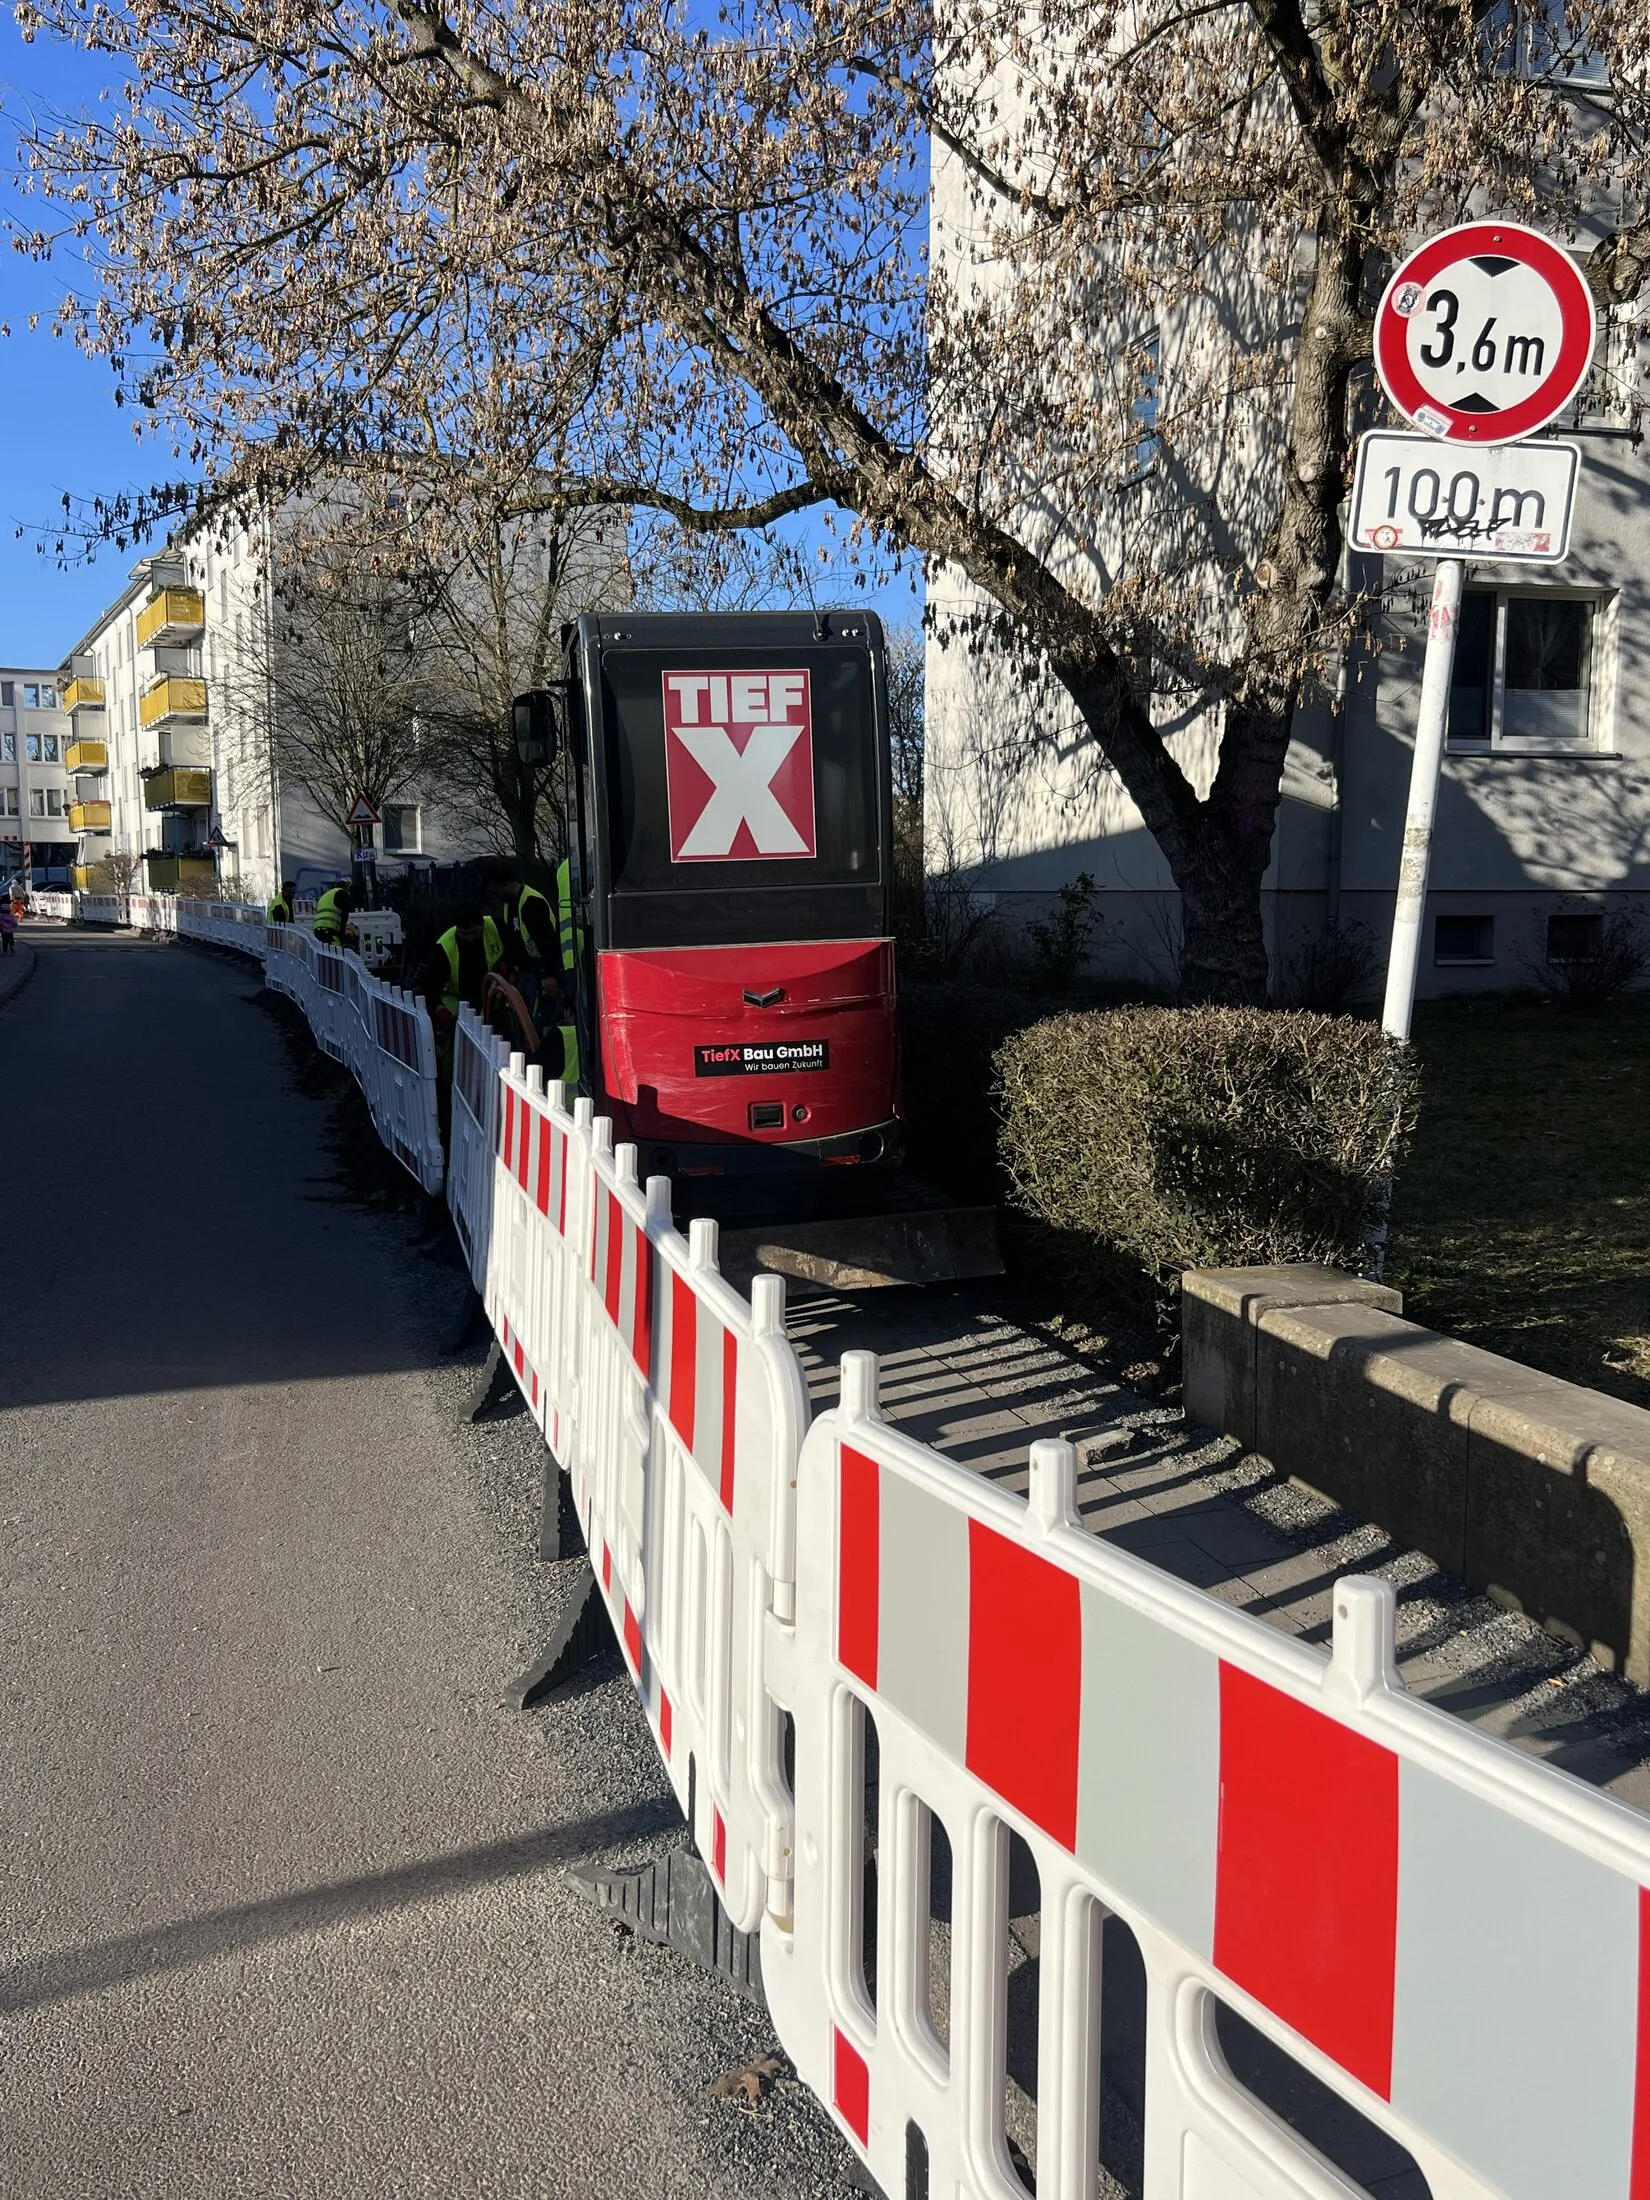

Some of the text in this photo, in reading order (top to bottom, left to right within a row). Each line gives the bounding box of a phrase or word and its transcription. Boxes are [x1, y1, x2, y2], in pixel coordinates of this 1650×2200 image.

[668, 675, 805, 723] TIEF
[670, 725, 811, 856] X
[701, 1044, 823, 1063] TiefX Bau GmbH
[744, 1059, 823, 1072] Wir bauen Zukunft
